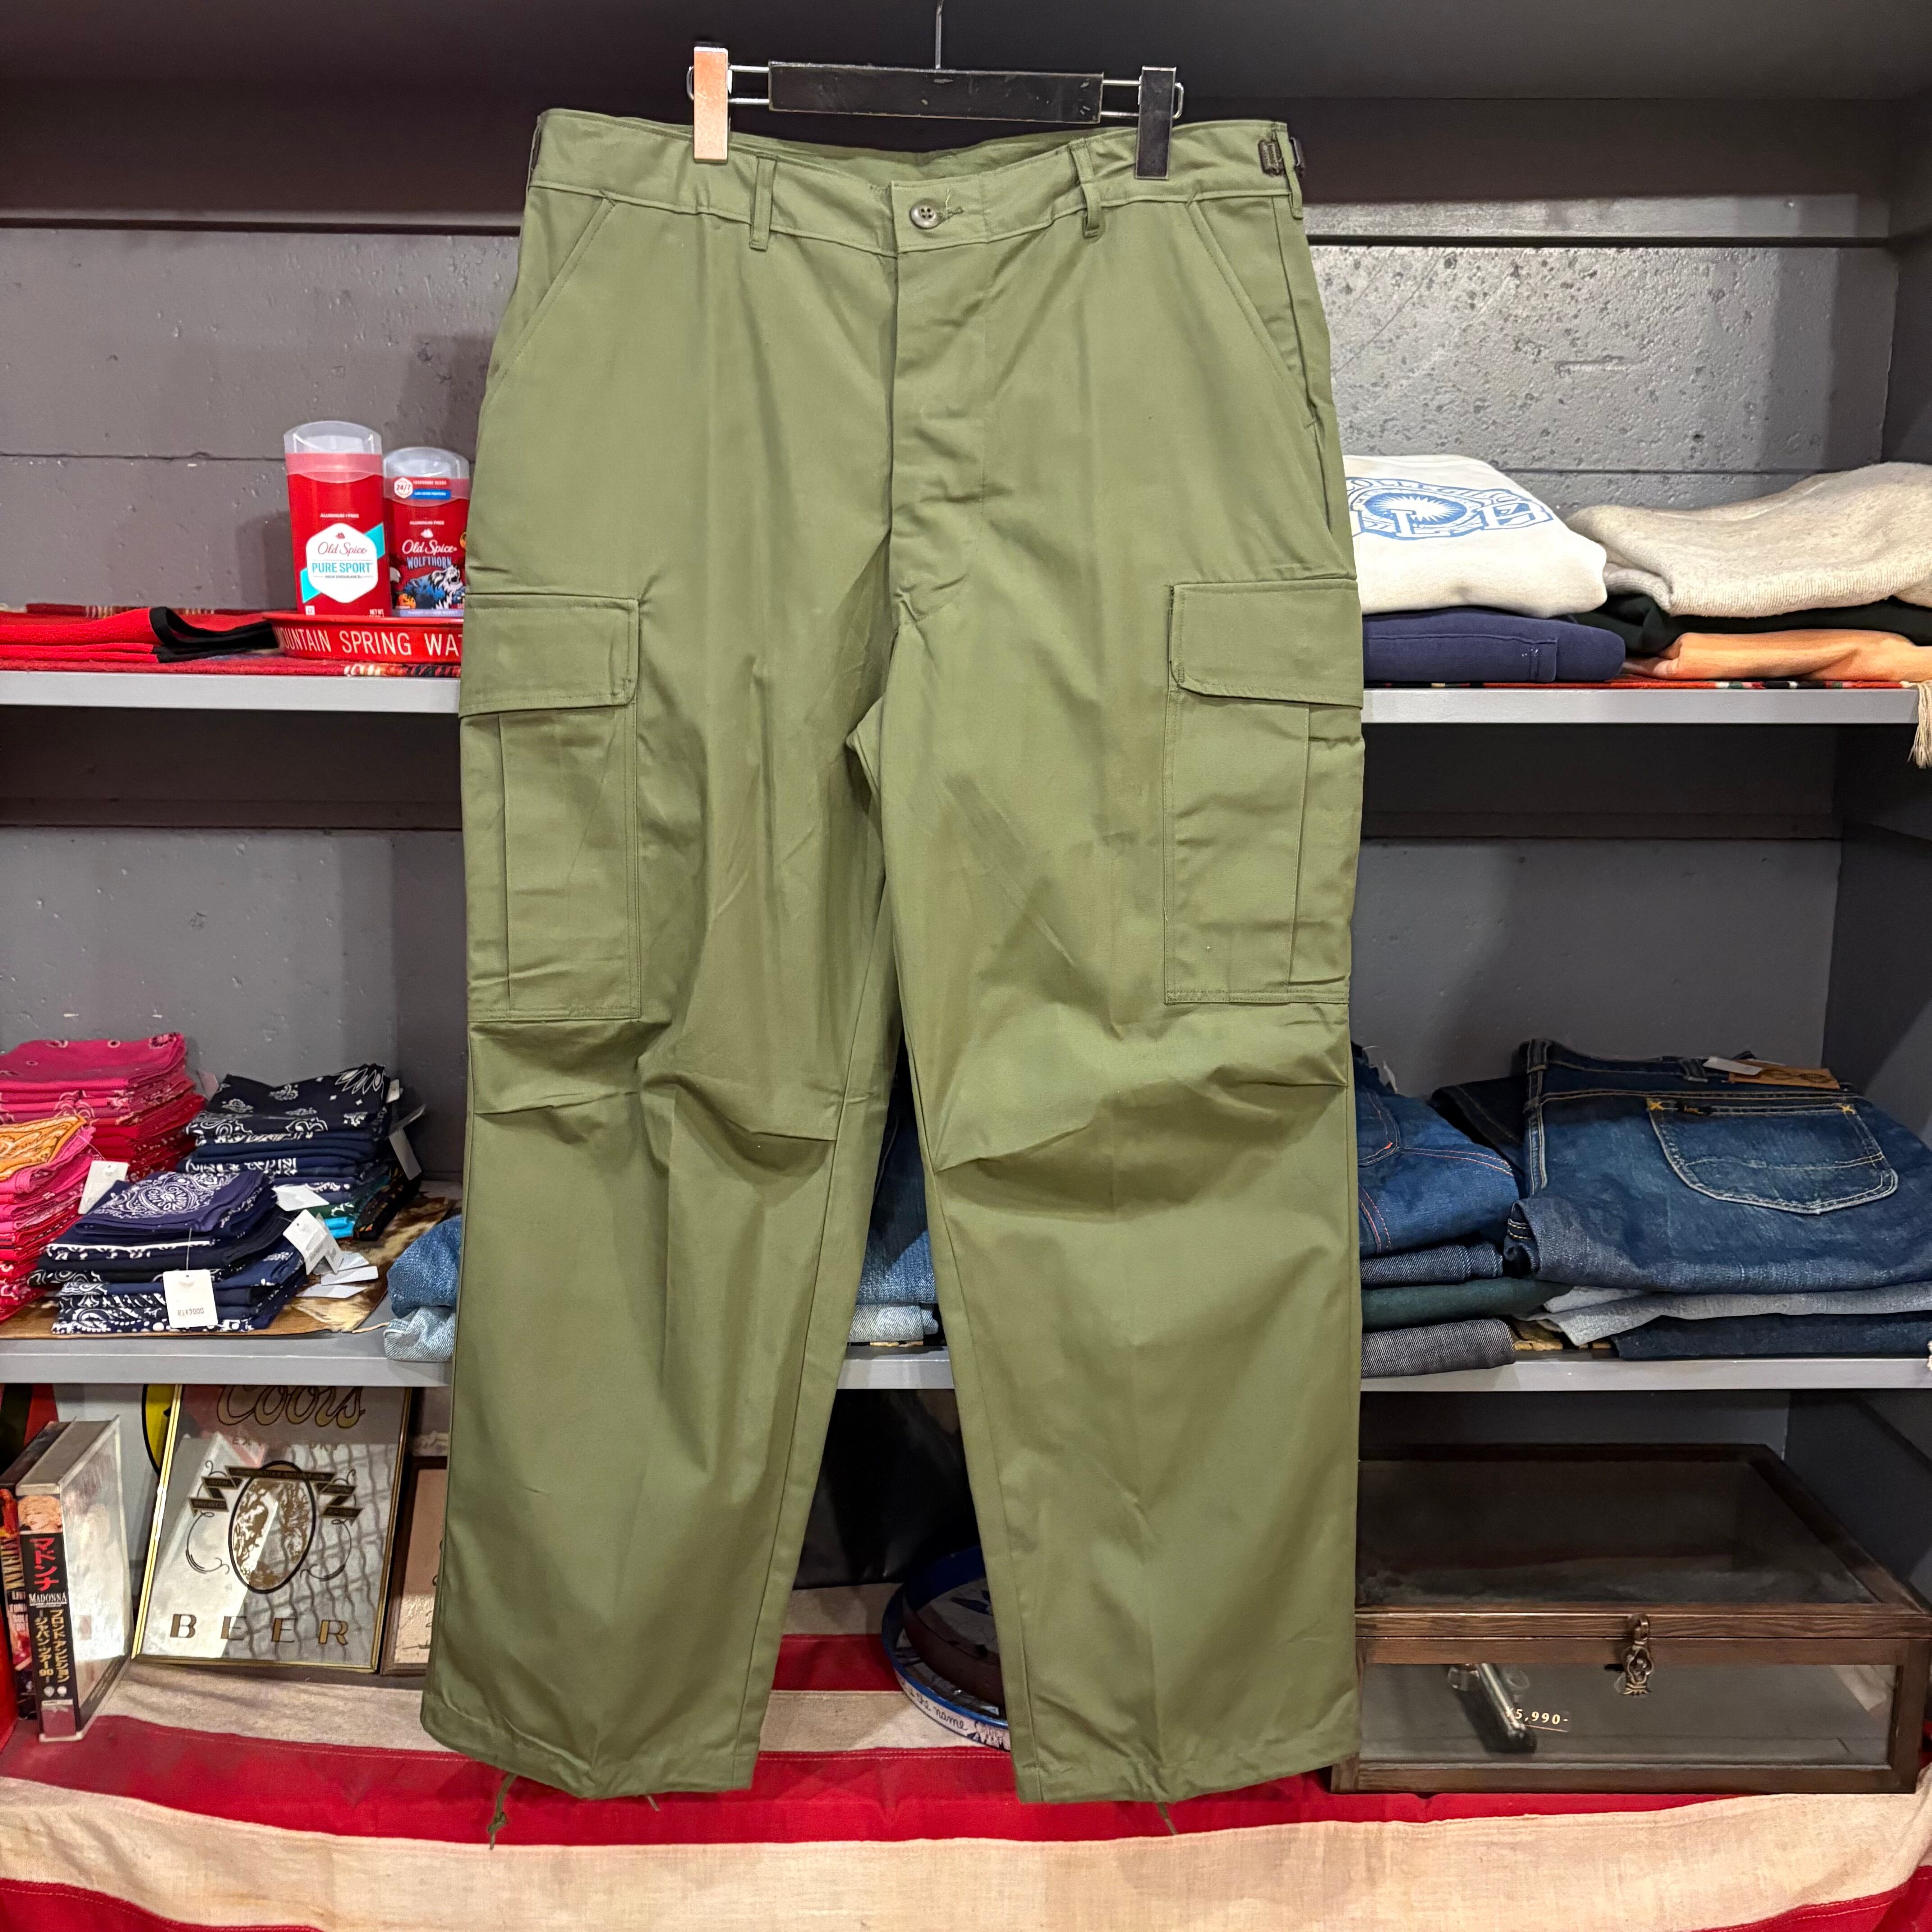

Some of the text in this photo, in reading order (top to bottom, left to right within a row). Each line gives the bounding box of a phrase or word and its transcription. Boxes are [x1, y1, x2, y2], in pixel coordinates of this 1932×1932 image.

[318, 542, 366, 557] Old Spice
[402, 539, 455, 556] Old Spice
[312, 562, 370, 573] PURE SPORT
[407, 556, 453, 570] WOLFTHORN
[339, 630, 412, 656] SPRING
[424, 633, 463, 656] WA
[217, 1385, 366, 1429] Coors
[29, 1537, 59, 1592] マドンナ
[29, 1592, 67, 1604] MADONNA
[170, 1613, 348, 1645] BEER
[934, 1706, 967, 1731] name
